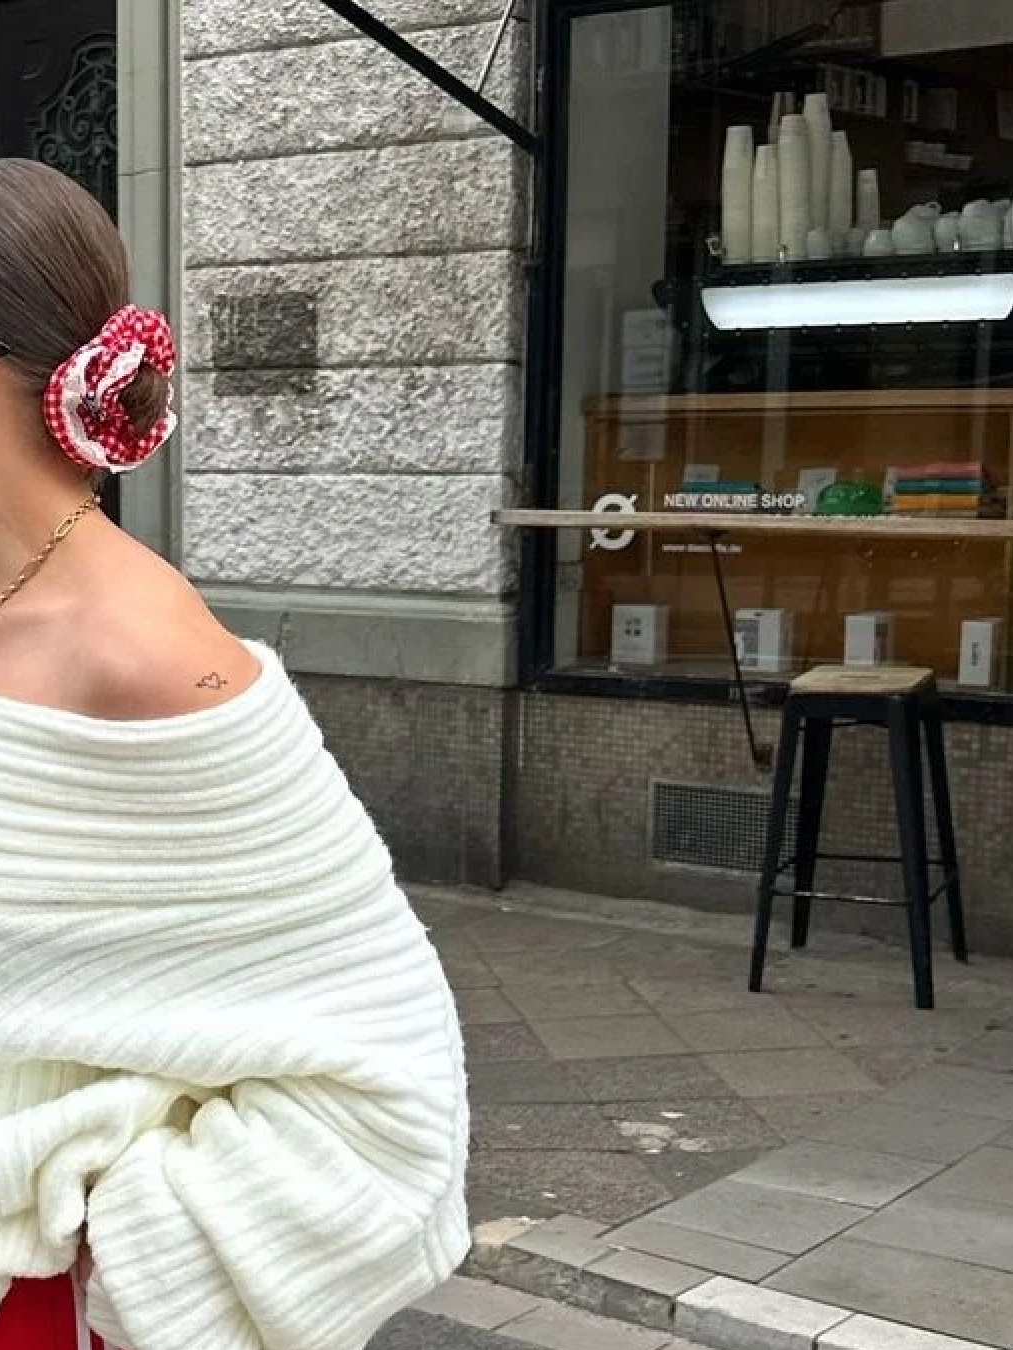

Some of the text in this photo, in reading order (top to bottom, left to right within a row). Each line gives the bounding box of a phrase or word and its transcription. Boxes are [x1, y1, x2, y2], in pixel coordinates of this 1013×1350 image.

[663, 493, 805, 508] NEW ONLINE SHOP
